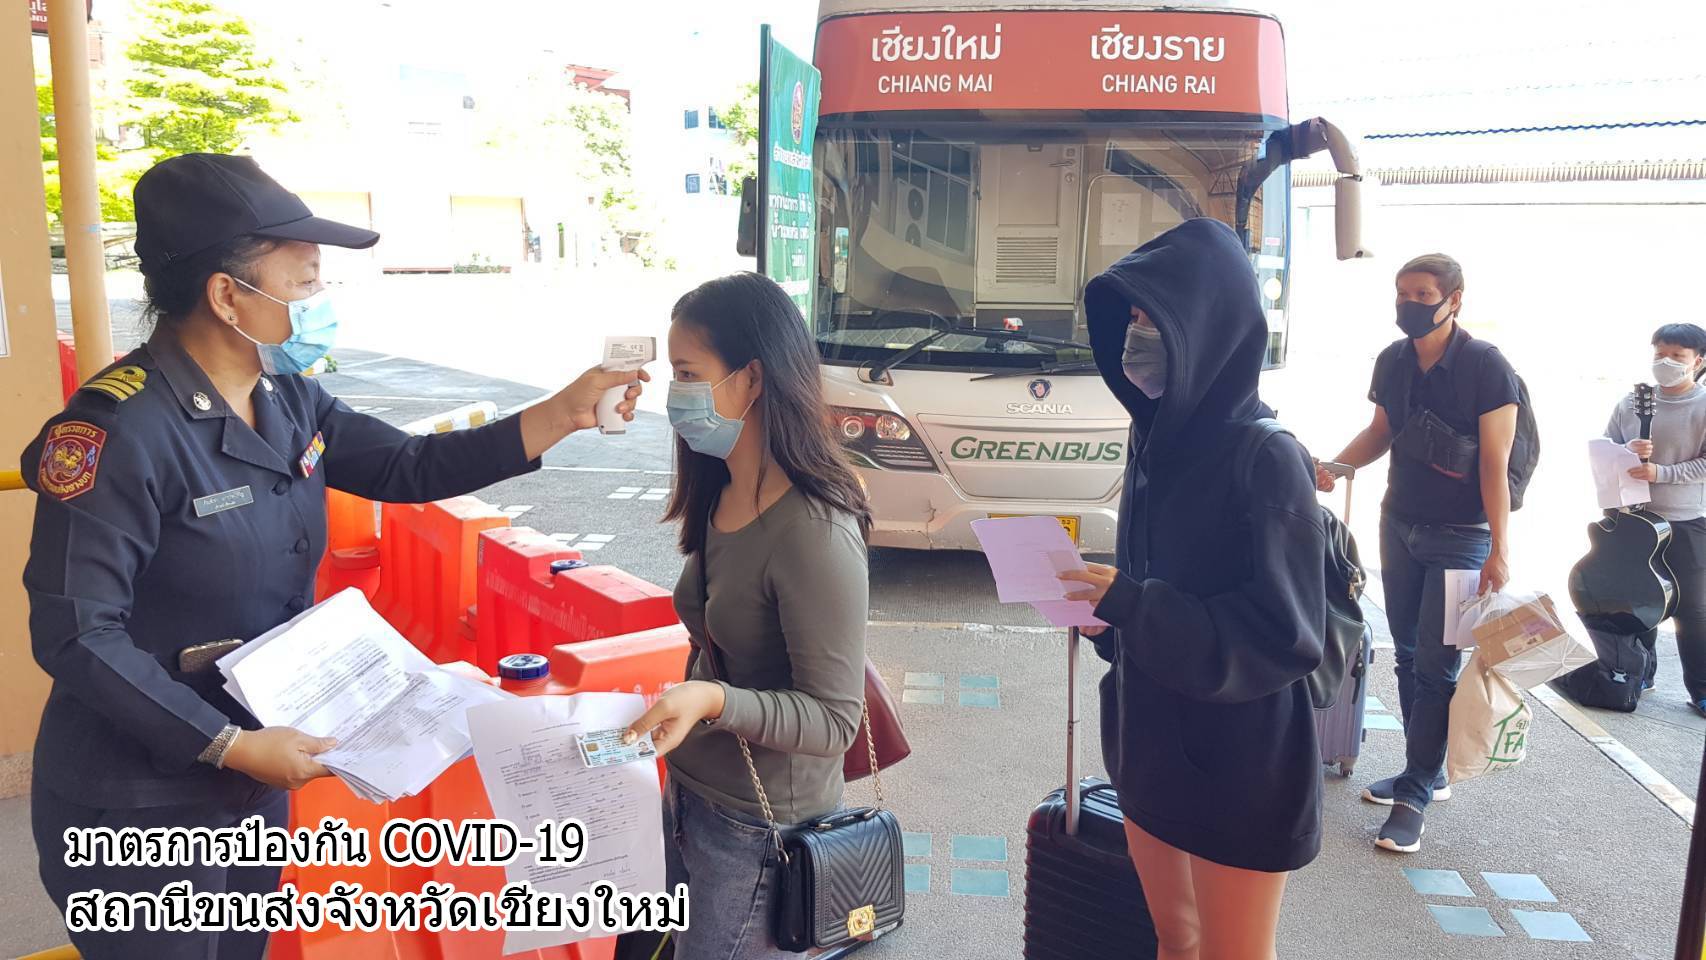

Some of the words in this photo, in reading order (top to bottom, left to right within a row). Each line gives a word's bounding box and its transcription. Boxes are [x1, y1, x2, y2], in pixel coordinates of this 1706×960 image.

[871, 24, 1002, 62] เชียงใหม่
[1090, 24, 1226, 62] เชียงราย
[877, 74, 952, 94] CHIANG
[958, 73, 993, 93] MAI
[1101, 74, 1178, 94] CHIANG
[1183, 75, 1217, 95] RAI
[1006, 402, 1073, 415] SCANIA
[950, 436, 1123, 462] GREENBUS
